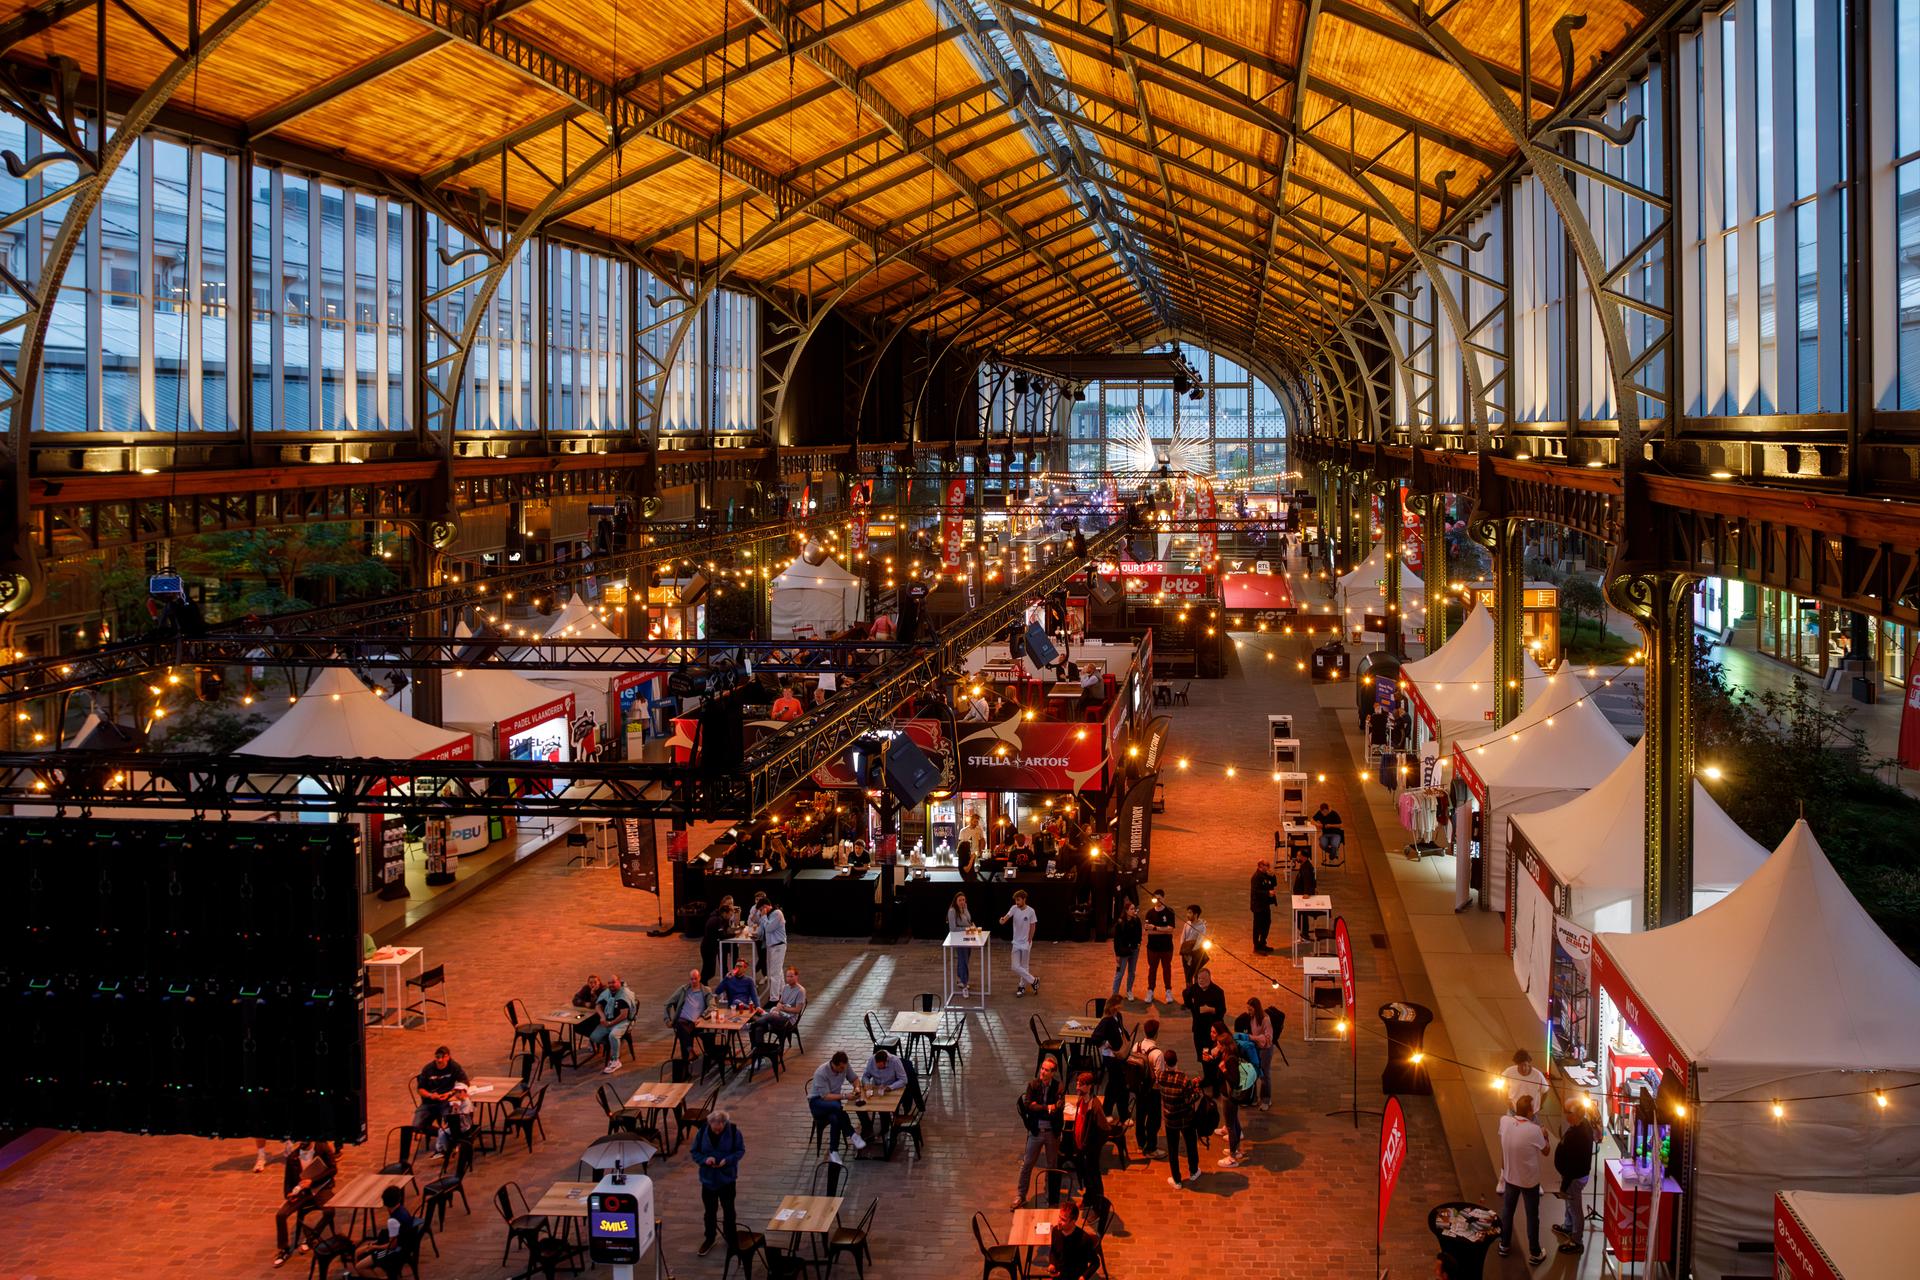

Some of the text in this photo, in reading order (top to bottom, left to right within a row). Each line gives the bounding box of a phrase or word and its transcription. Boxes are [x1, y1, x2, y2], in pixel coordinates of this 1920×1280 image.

[1117, 564, 1145, 573] OURT
[514, 703, 563, 730] PADEL VLAANDEREN
[968, 756, 1069, 767] STELLA ARTOIS
[452, 825, 480, 840] PBU
[1131, 806, 1143, 854] TORREFACTORY
[1625, 996, 1639, 1026] NOX
[600, 1219, 629, 1232] SMILE
[1785, 1226, 1815, 1279] bounce
